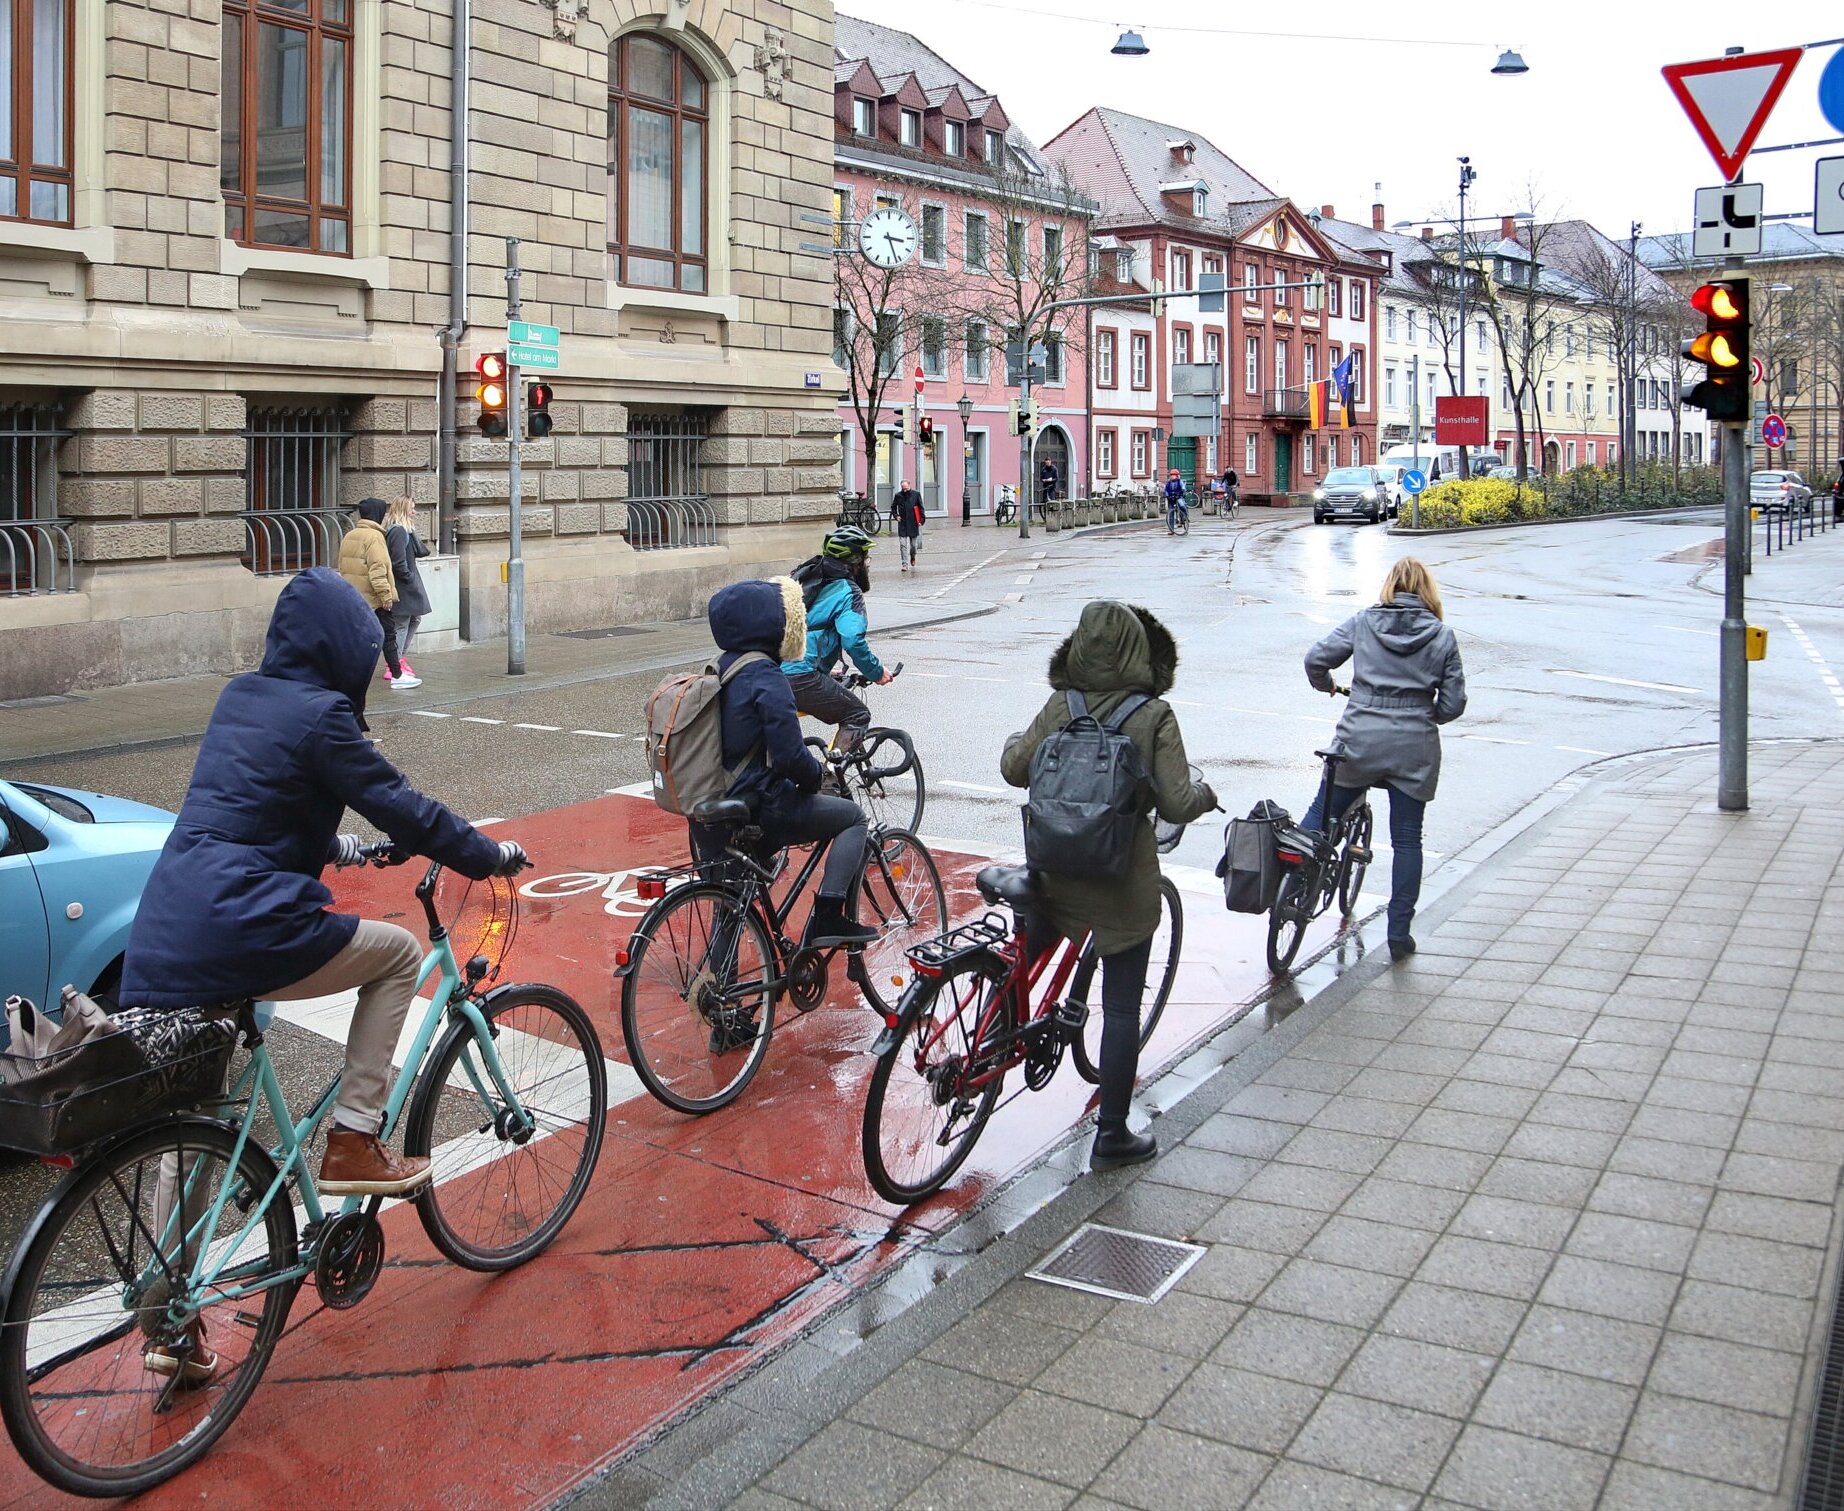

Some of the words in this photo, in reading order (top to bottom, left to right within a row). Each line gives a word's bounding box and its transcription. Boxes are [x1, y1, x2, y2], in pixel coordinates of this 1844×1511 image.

[518, 350, 532, 361] Hotel
[532, 353, 542, 363] am
[542, 352, 557, 364] Markt
[1439, 416, 1480, 425] Kunsthalle
